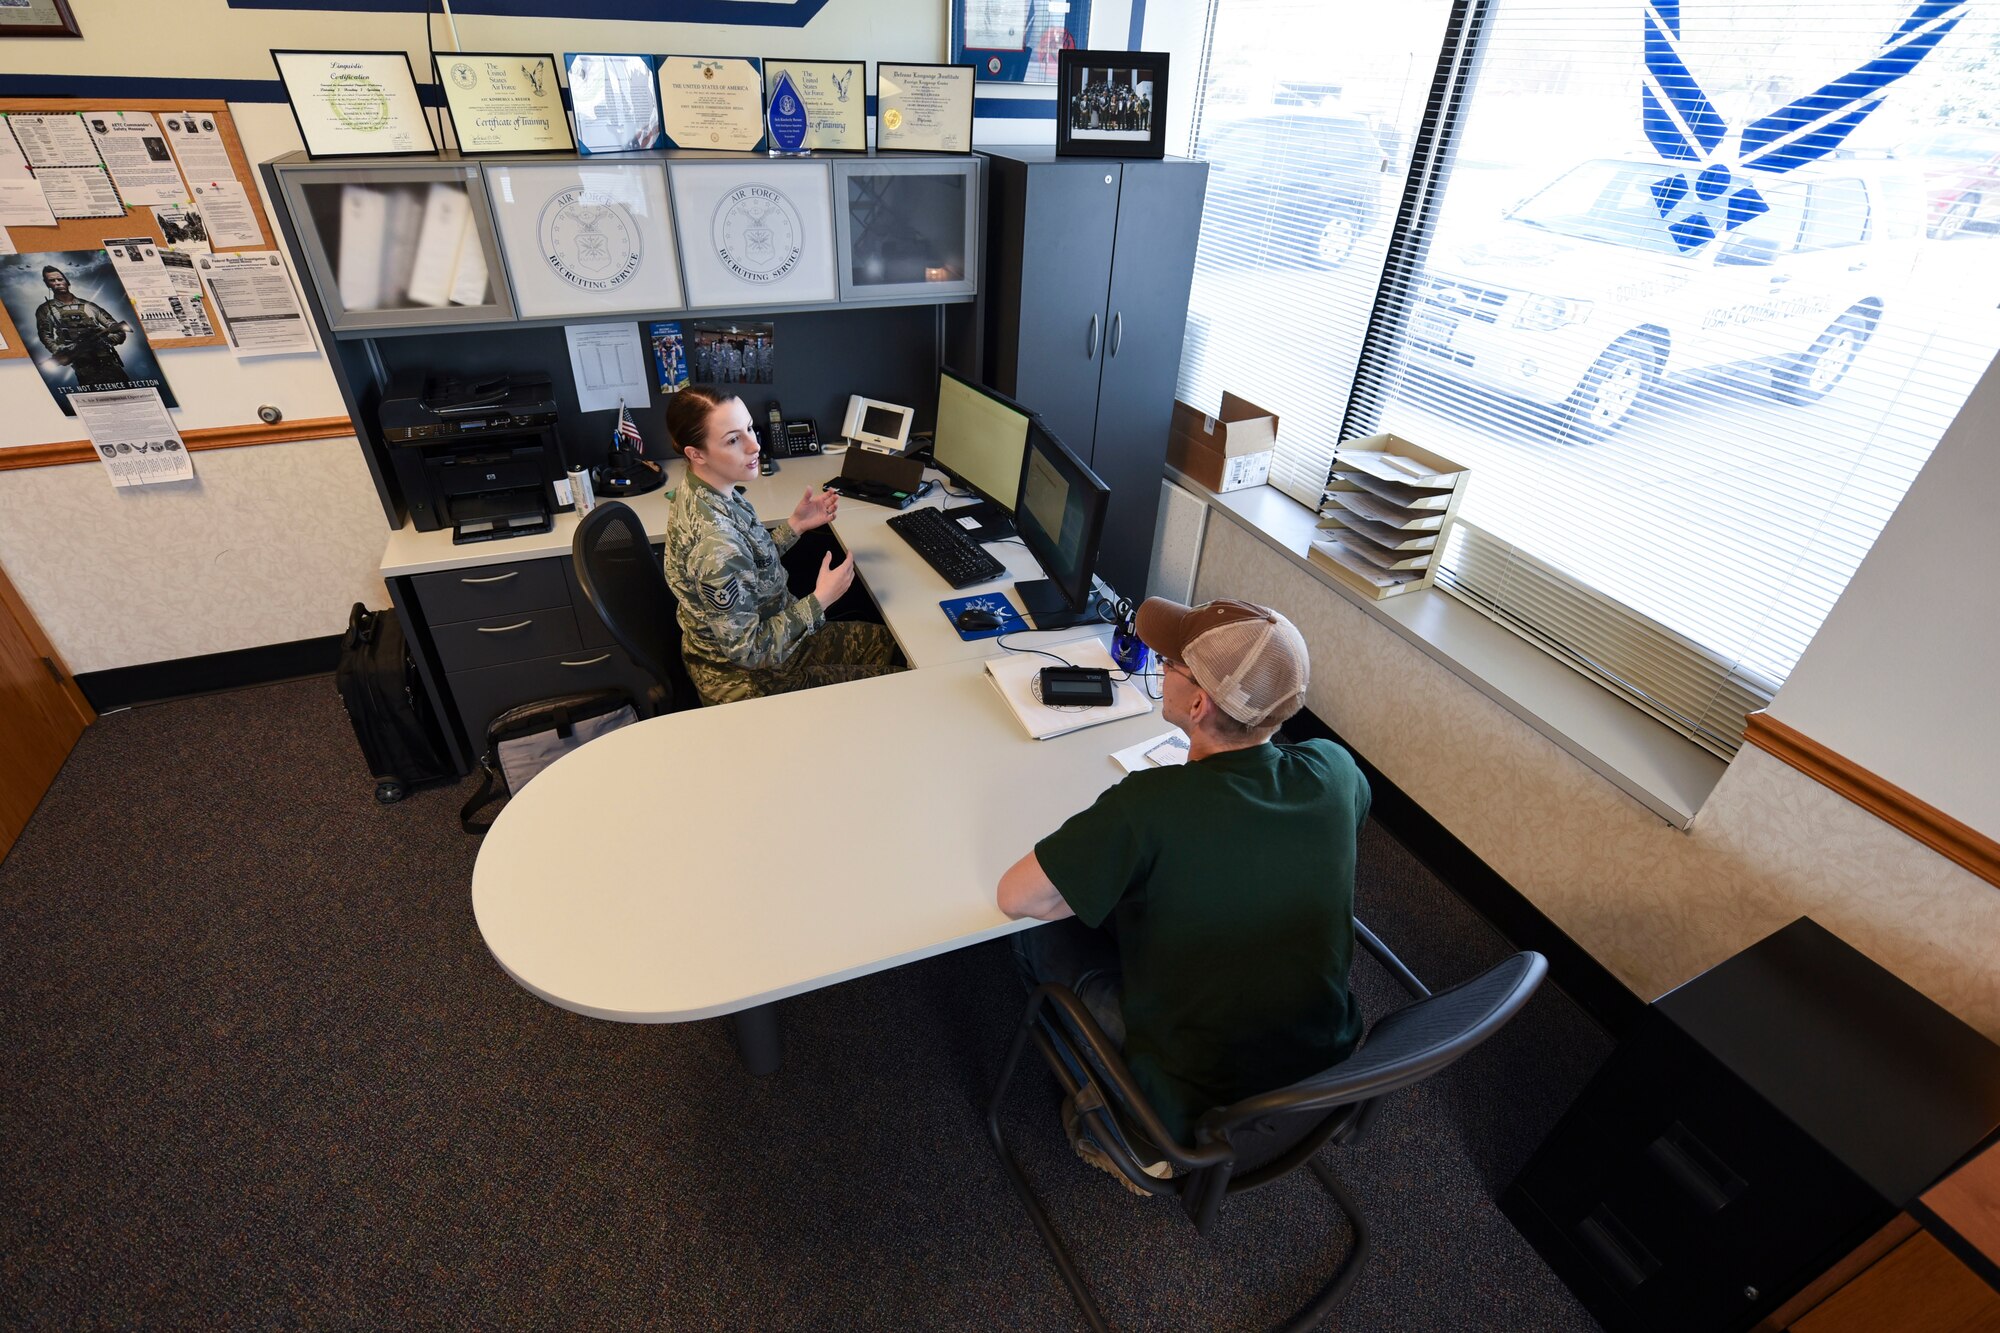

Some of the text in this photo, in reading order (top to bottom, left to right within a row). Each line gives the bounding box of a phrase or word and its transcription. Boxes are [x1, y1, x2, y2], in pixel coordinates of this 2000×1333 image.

[330, 73, 369, 81] Certification
[475, 116, 549, 131] Certificate of Training
[822, 121, 846, 133] Training
[556, 191, 613, 208] AIR FORCE
[731, 188, 781, 203] AIR FORCE
[549, 252, 638, 288] RECRUITING SERVICE
[720, 246, 800, 280] RECRUITING SERVICE
[94, 382, 126, 391] SCIENCE
[128, 379, 159, 388] FICTION
